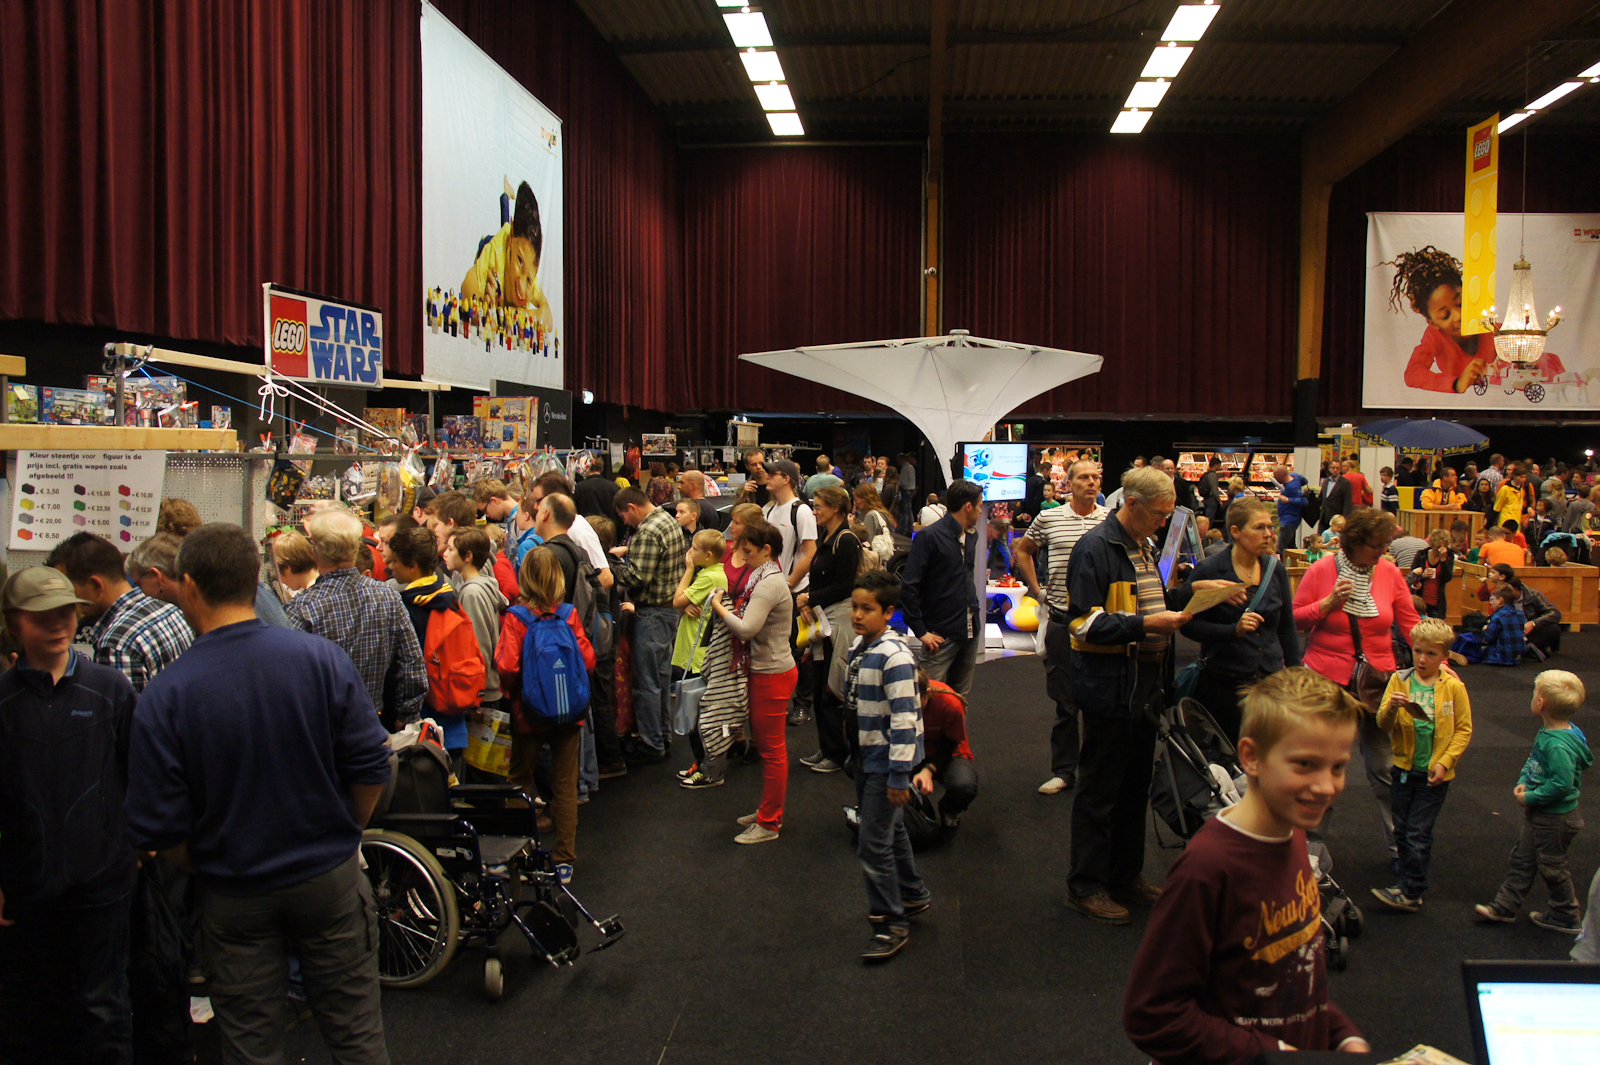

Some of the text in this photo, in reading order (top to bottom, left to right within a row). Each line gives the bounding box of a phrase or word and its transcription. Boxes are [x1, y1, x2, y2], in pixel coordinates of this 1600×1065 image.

[1474, 137, 1491, 160] LEGO
[273, 319, 305, 353] LEGO
[309, 304, 380, 348] STAR
[310, 340, 380, 383] WARS
[27, 462, 43, 470] prijs
[28, 472, 65, 480] afgebeeld
[1260, 1017, 1285, 1026] WORK
